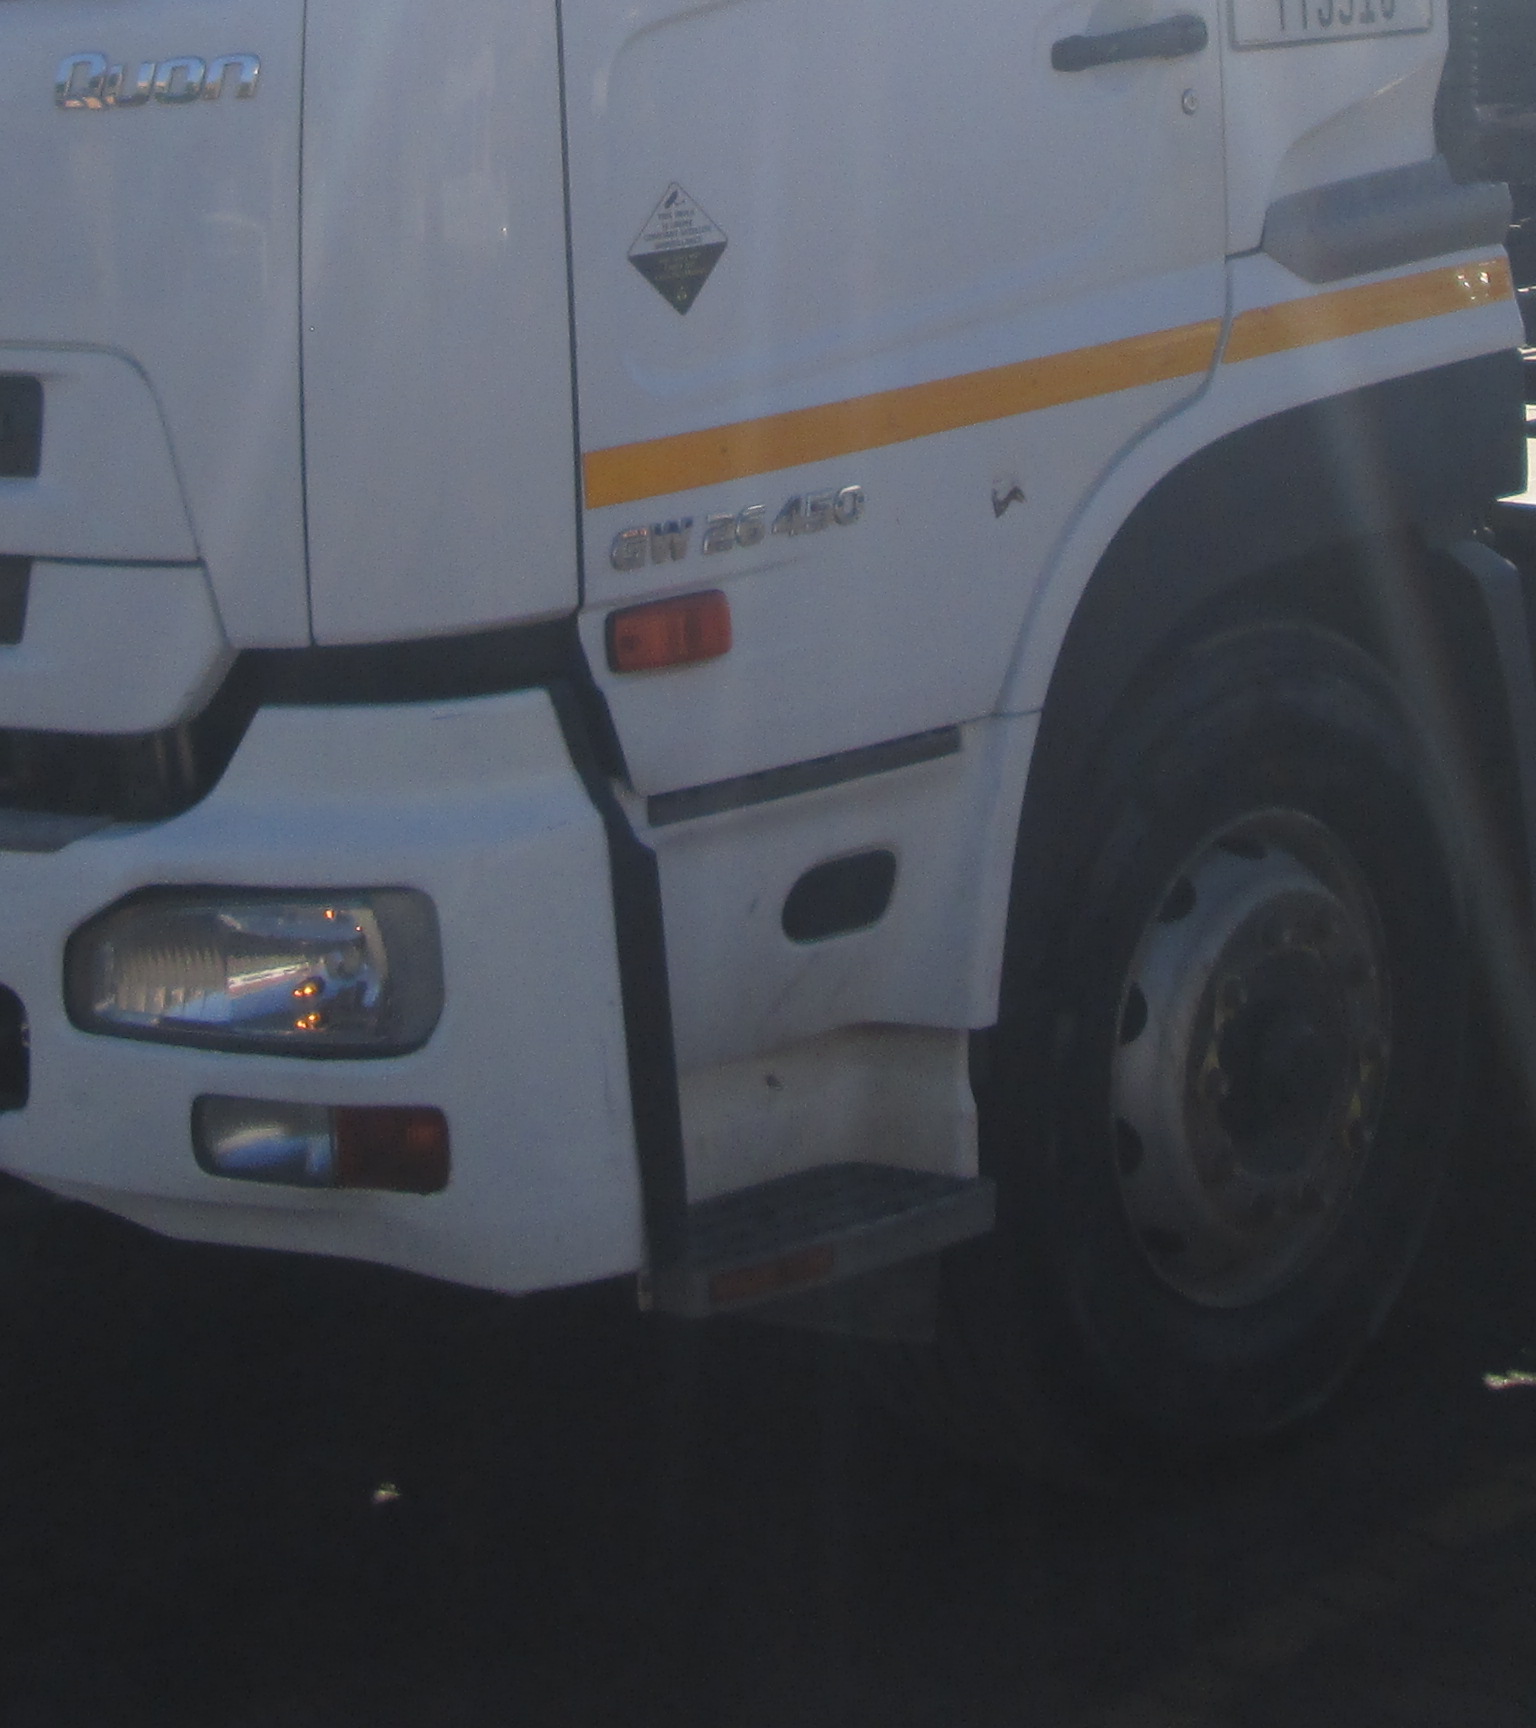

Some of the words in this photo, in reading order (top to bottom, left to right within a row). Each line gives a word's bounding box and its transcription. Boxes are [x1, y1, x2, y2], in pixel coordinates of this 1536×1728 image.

[610, 515, 695, 572] GW
[702, 503, 767, 556] 26
[770, 484, 866, 537] 450
